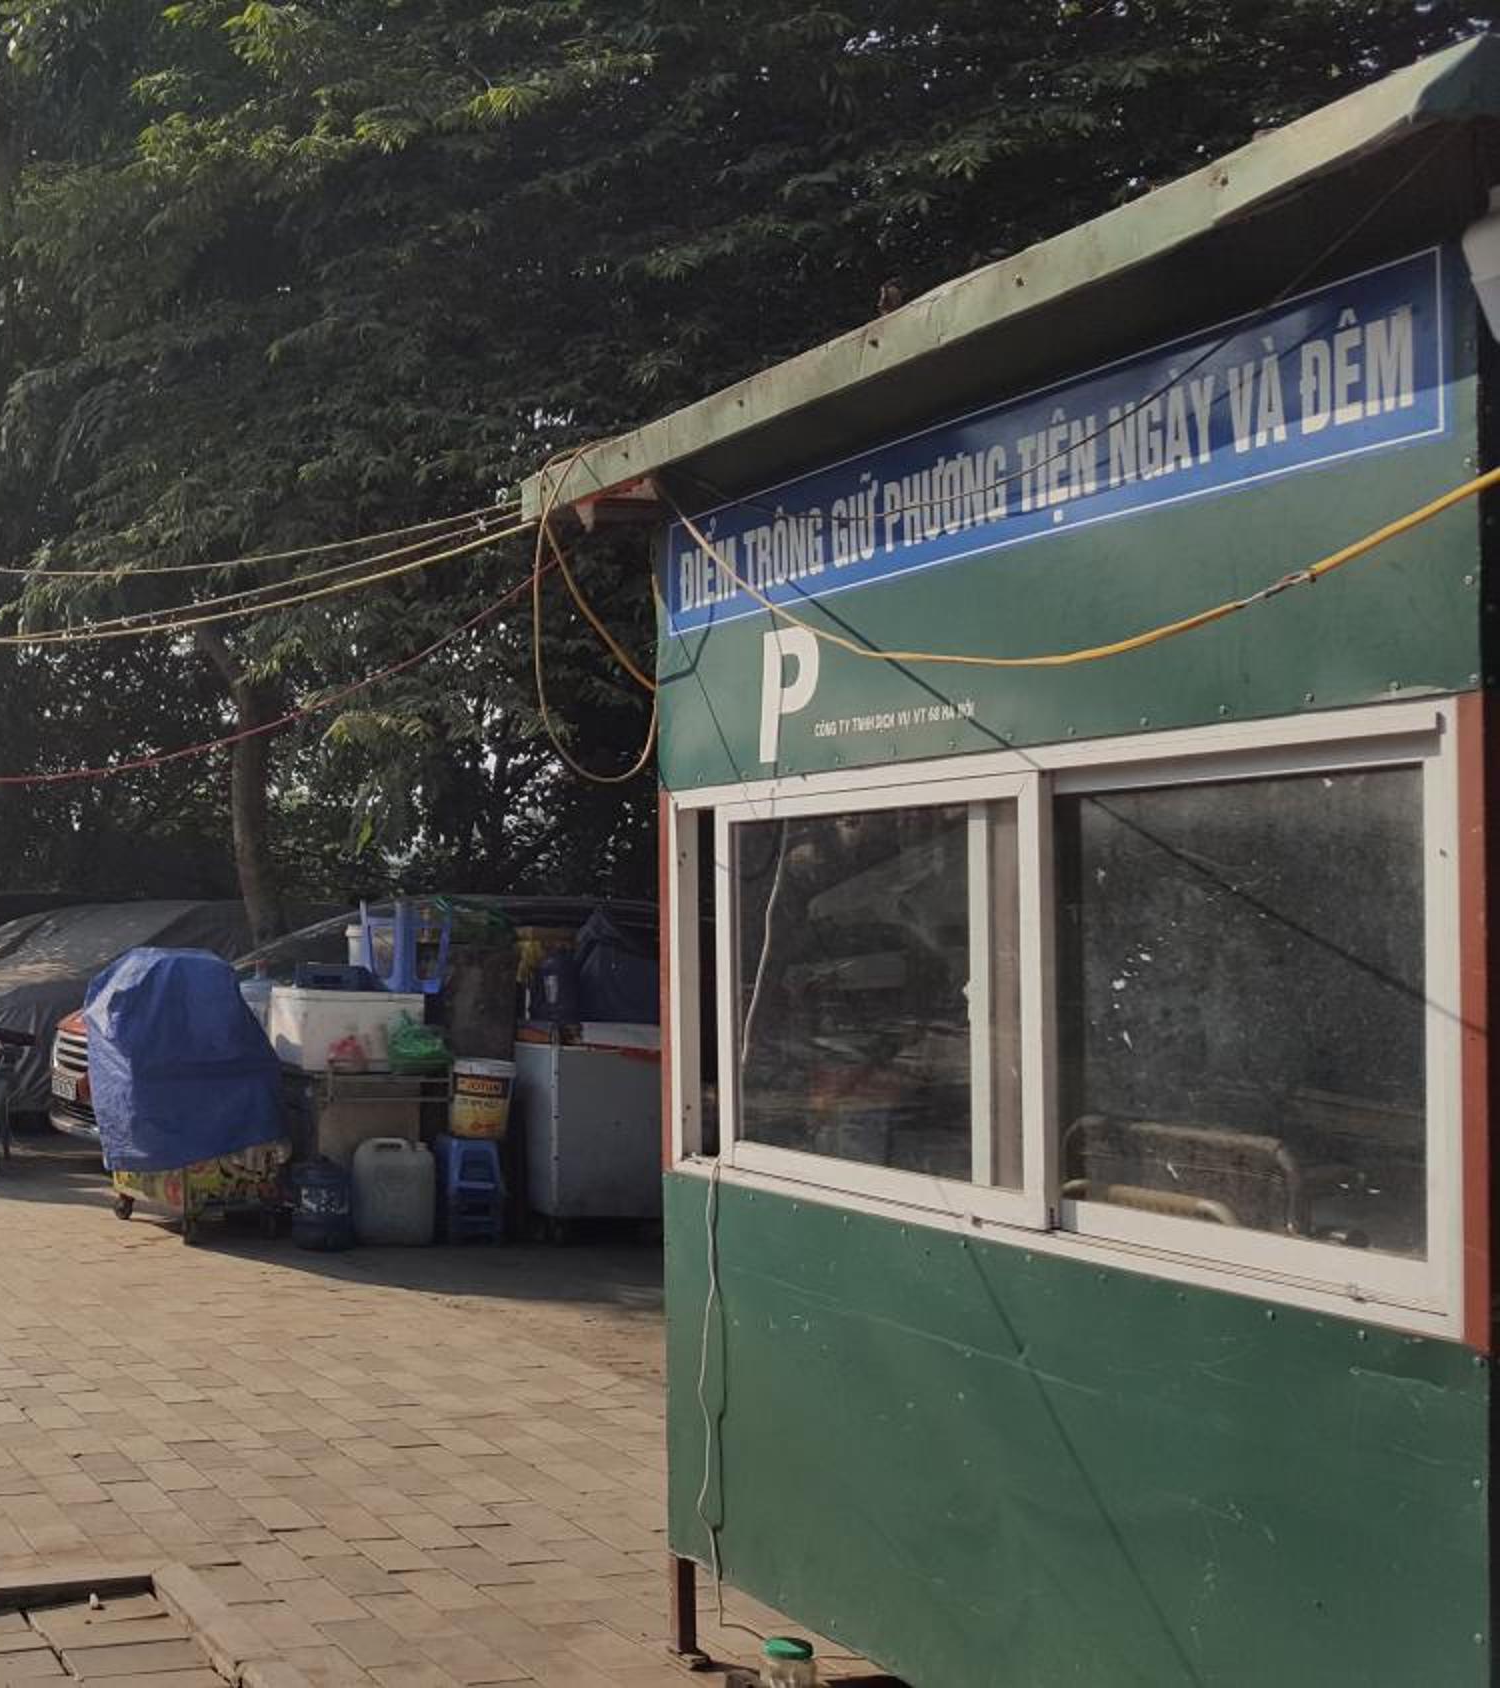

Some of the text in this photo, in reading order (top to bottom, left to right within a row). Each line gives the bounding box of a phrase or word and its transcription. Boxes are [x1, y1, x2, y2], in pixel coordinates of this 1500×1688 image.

[679, 304, 1414, 612] ĐIỂM TRÔNG GIỮ PHƯƠNG TIỆN NGÀY VÀ ĐÊM
[759, 626, 819, 763] P
[839, 719, 850, 734] TY
